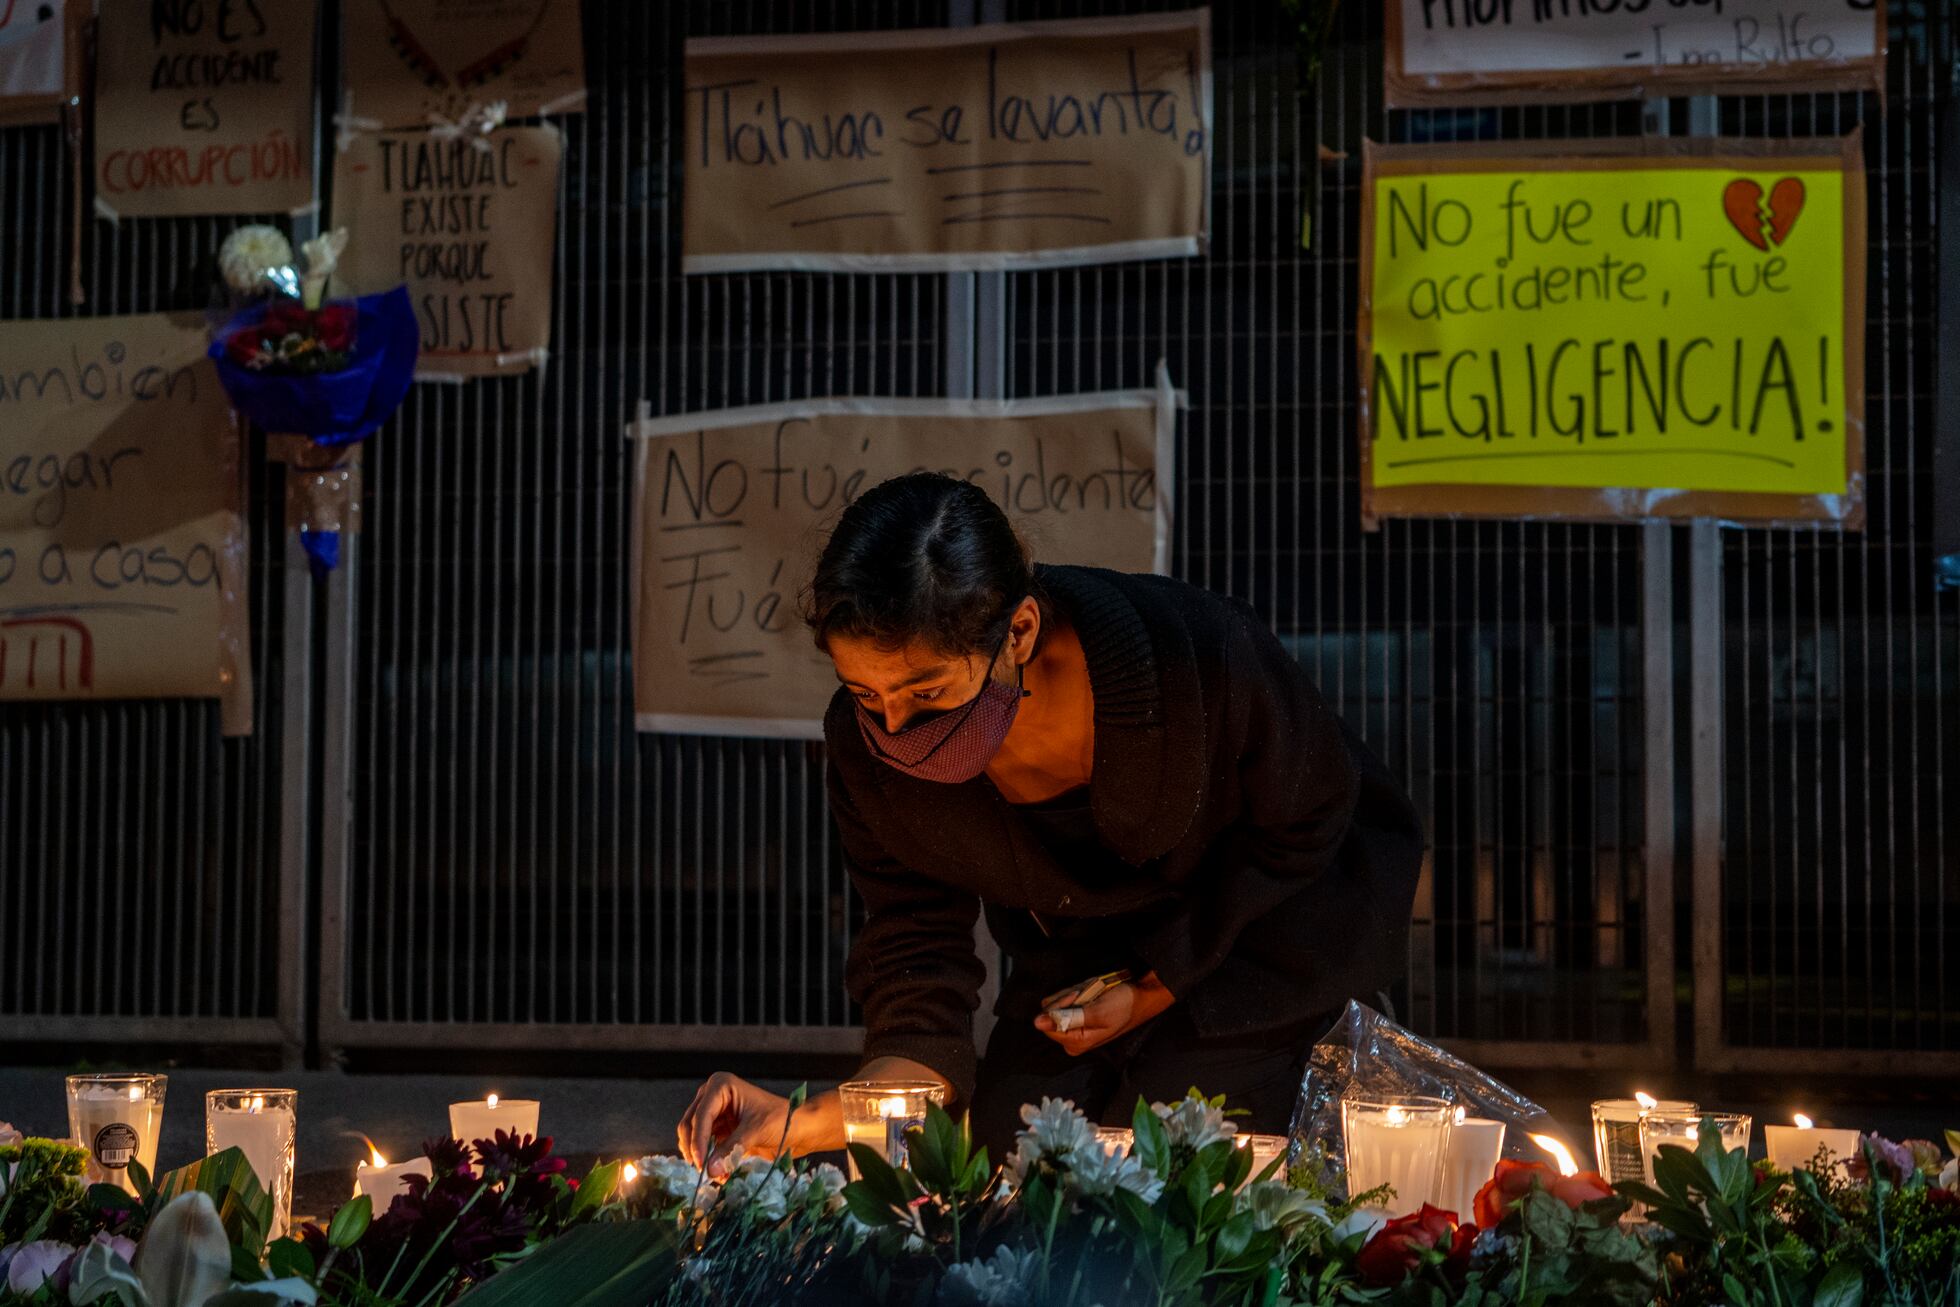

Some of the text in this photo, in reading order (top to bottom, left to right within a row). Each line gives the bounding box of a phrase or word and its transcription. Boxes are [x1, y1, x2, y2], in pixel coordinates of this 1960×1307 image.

[153, 0, 204, 44] NO
[152, 50, 282, 91] ACCIDENTE
[180, 99, 220, 131] ES
[900, 105, 971, 144] se
[103, 128, 302, 193] CORRUPCIÓN
[402, 195, 491, 235] EXISTE
[1390, 179, 1682, 261] No fue un
[401, 242, 494, 284] PORQUE
[1408, 247, 1792, 321] accidente, fue
[422, 293, 516, 352] SISTE
[1371, 335, 1835, 444] NEGLIGENCIA!
[0, 446, 144, 527] egar
[40, 543, 72, 584] a
[91, 540, 223, 591] casa
